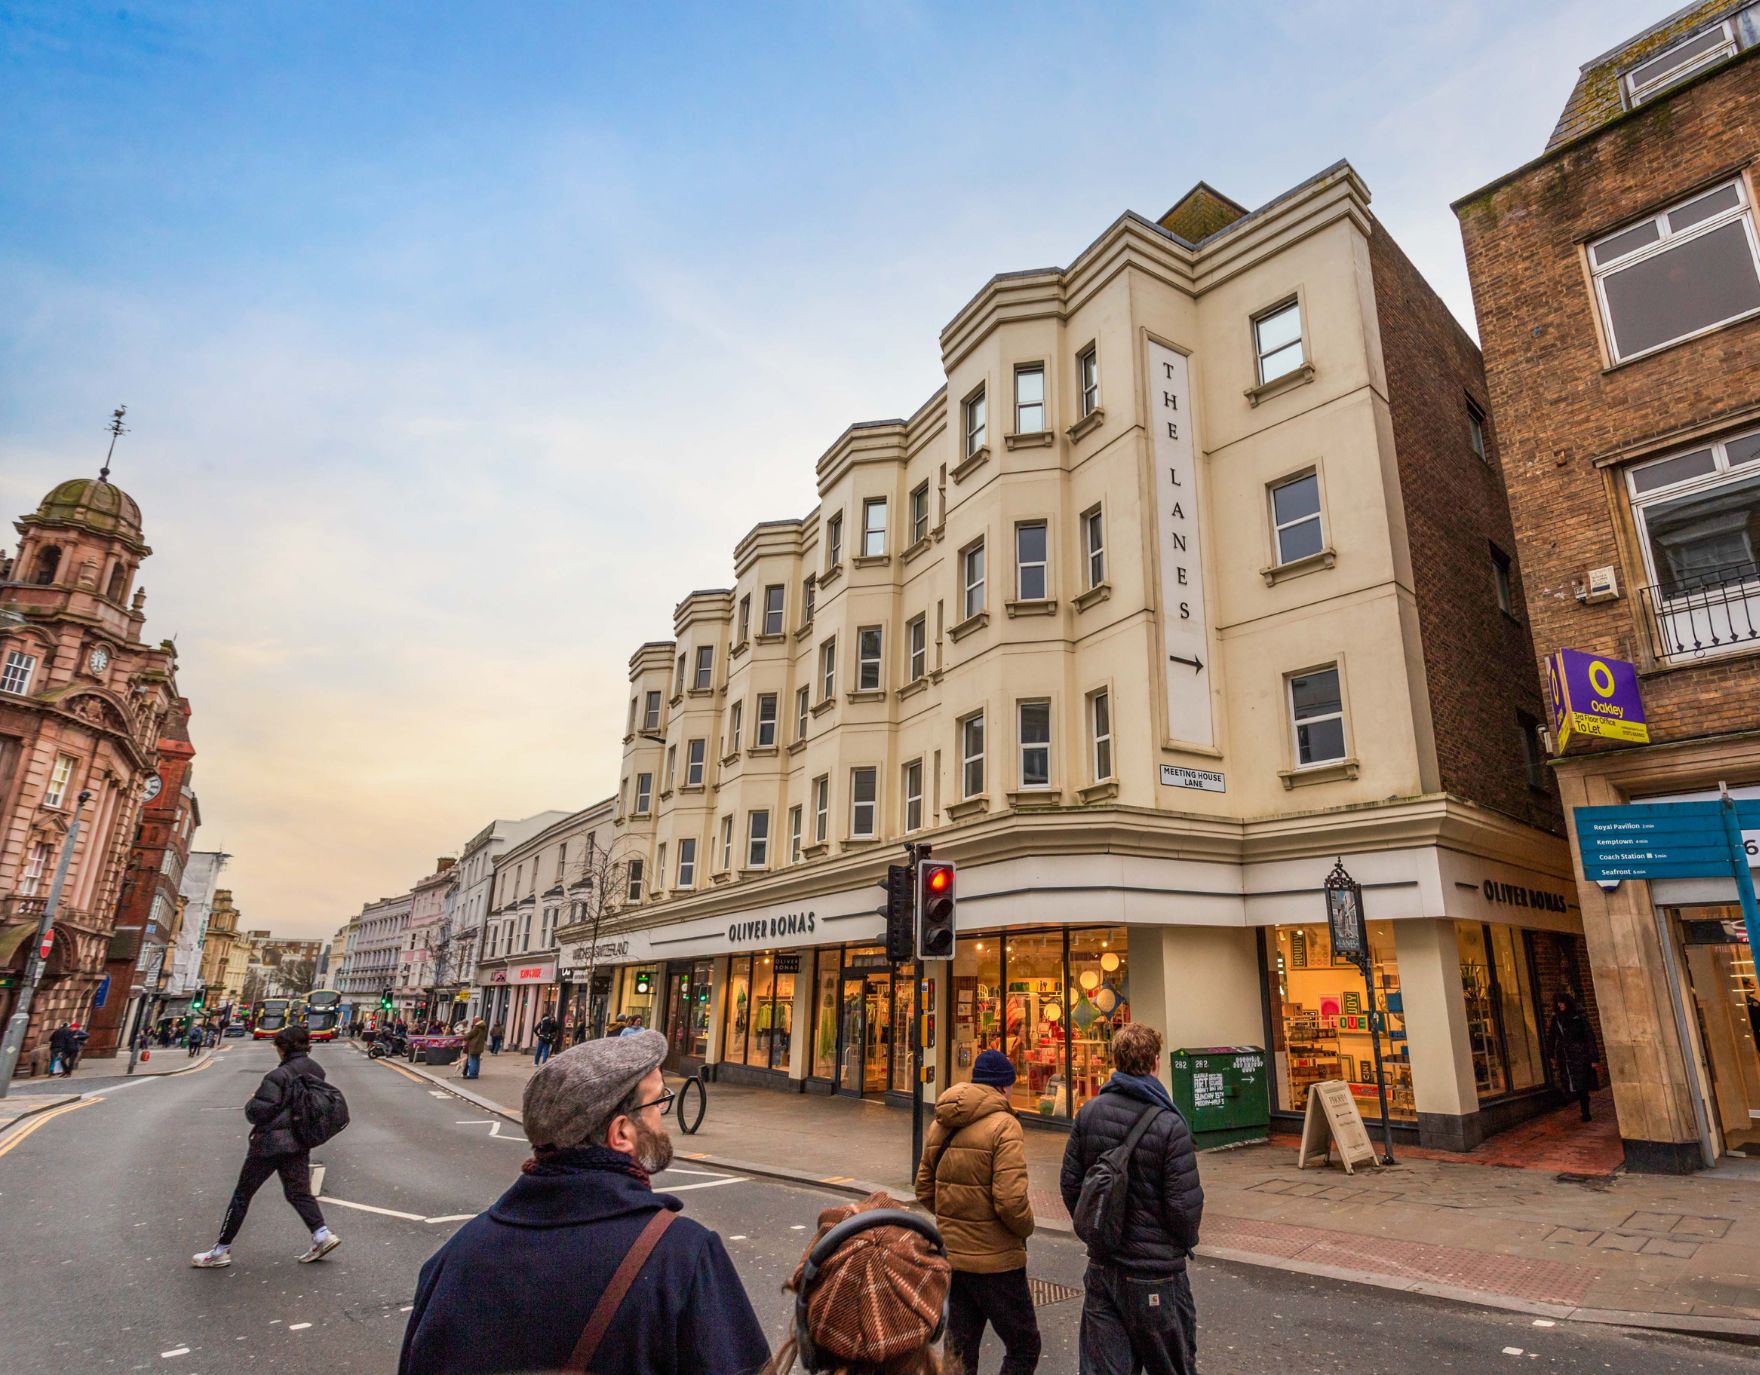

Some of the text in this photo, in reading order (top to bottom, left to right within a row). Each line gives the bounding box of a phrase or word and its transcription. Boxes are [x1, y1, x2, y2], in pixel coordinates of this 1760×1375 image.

[1162, 362, 1190, 620] THE LANES
[1591, 699, 1624, 718] Oakley
[1576, 720, 1601, 734] To Let
[1163, 767, 1222, 782] MEETING HOUSE
[1184, 778, 1203, 788] LANE
[1593, 823, 1613, 831] Royal
[1613, 822, 1640, 830] Pavilion
[1599, 853, 1620, 861] Coach
[1620, 852, 1646, 860] Station
[1601, 868, 1632, 876] Seafront
[1483, 879, 1528, 907] OLIVER
[728, 911, 815, 942] OLIVER BONAS
